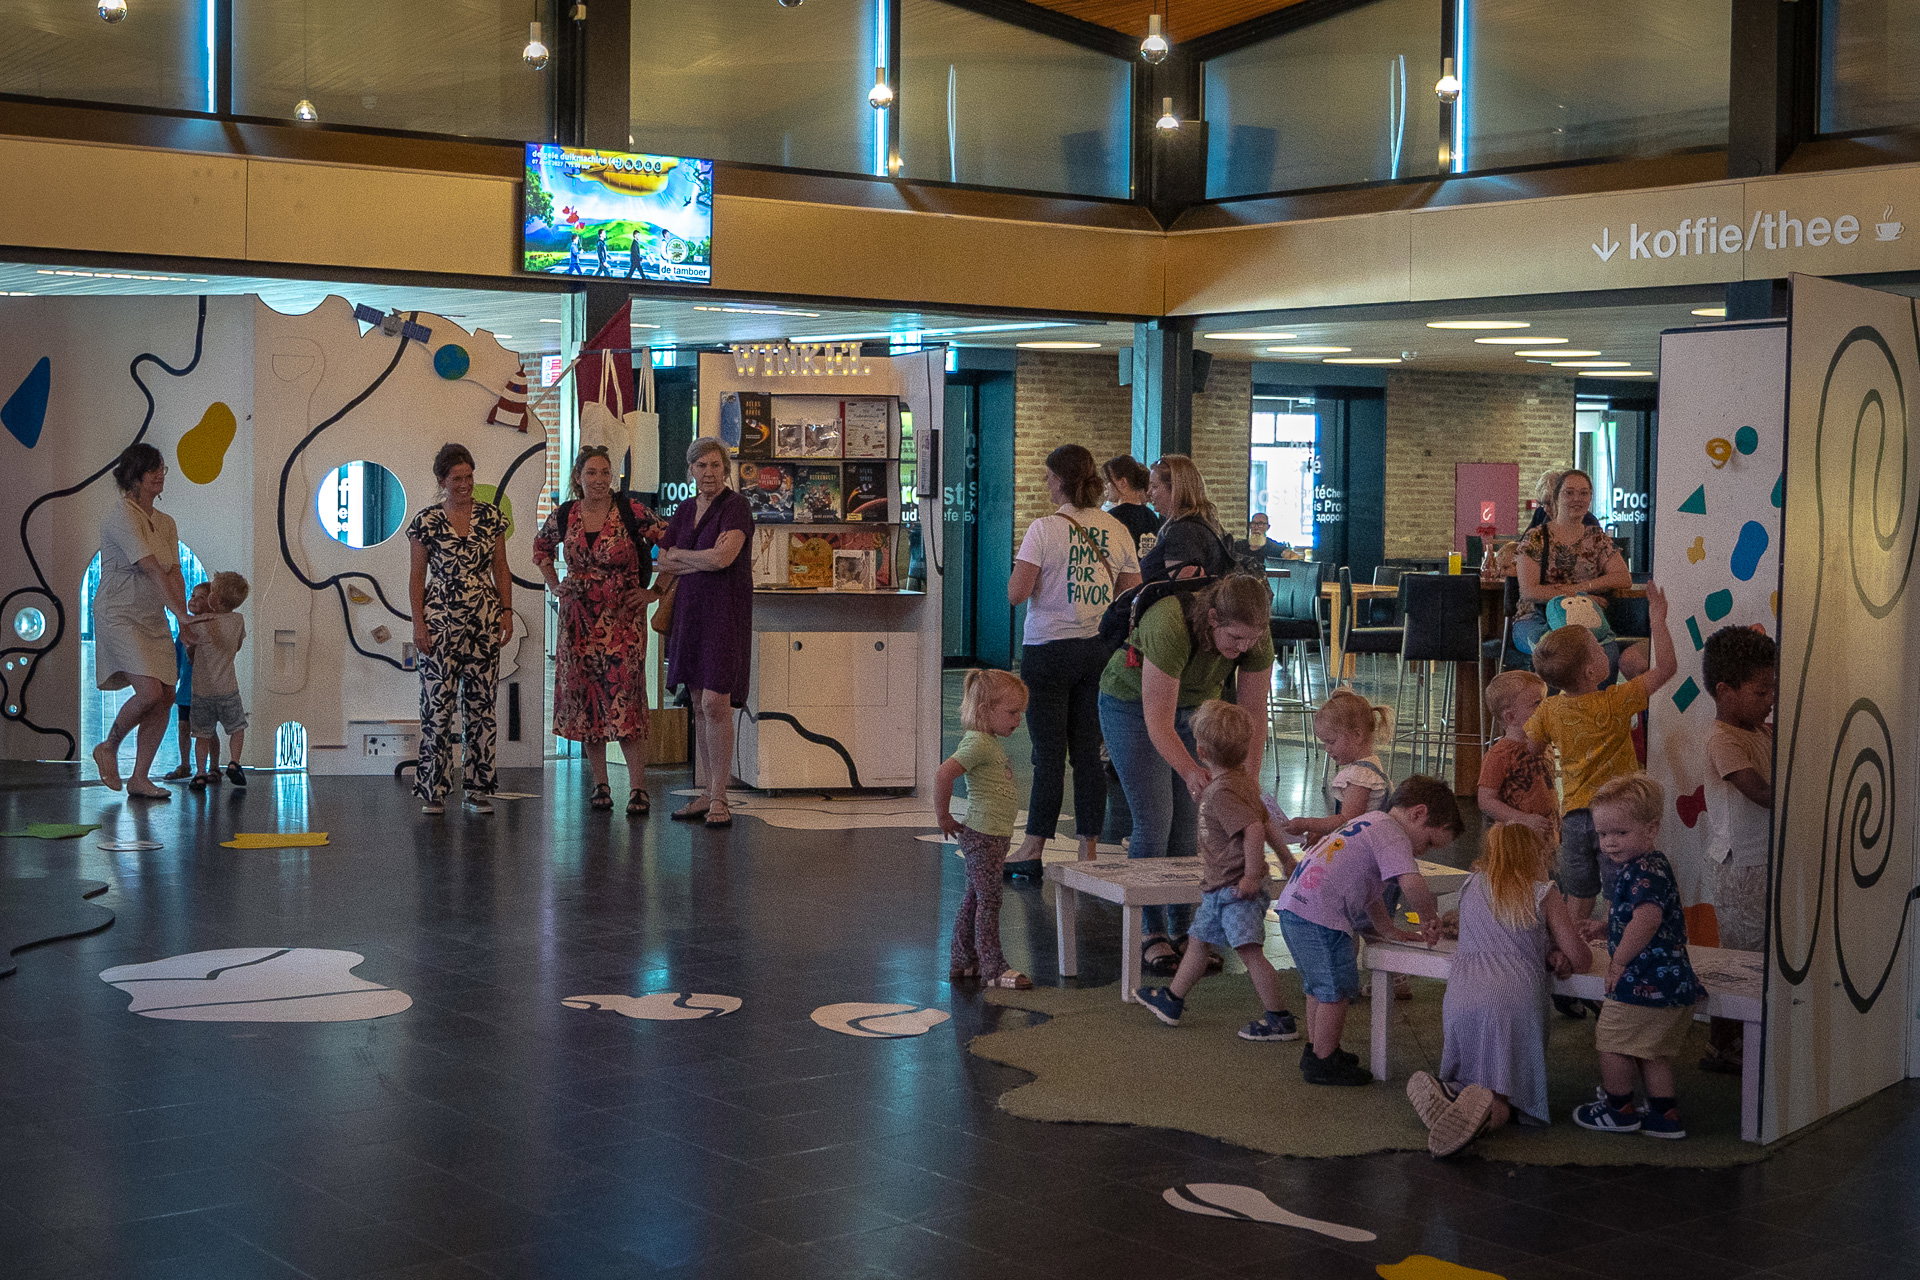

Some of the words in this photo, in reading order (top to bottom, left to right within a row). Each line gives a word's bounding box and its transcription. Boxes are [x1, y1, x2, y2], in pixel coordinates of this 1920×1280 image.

[560, 152, 607, 164] duikmachine
[1630, 210, 1860, 260] koffie/thee
[661, 265, 671, 274] de
[673, 267, 707, 276] tamboer
[730, 342, 871, 377] WINKEL
[1612, 511, 1634, 522] Salud
[1068, 524, 1110, 549] MORE
[1066, 565, 1096, 584] POR
[1066, 582, 1111, 606] FAVOR
